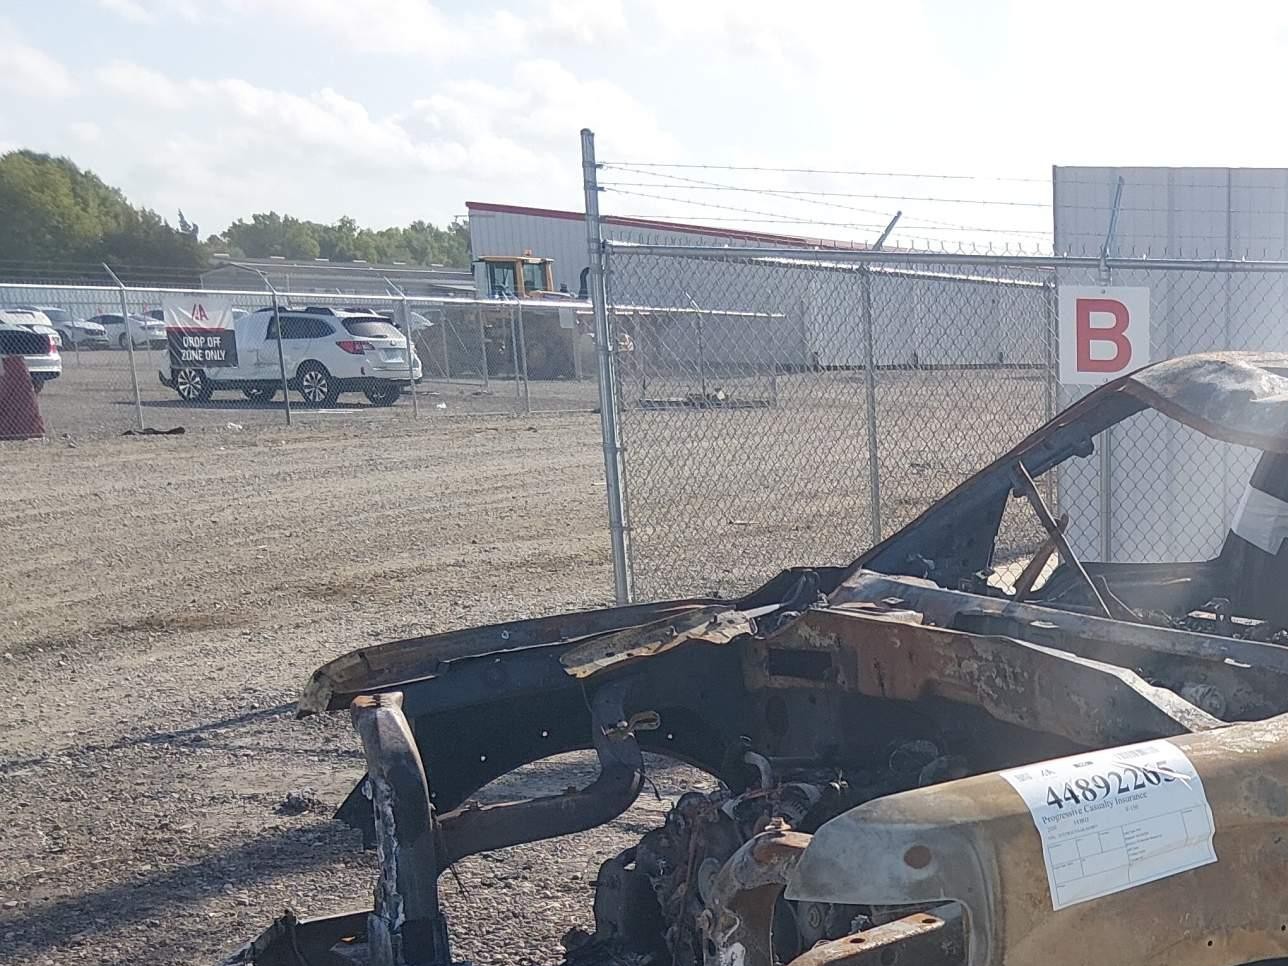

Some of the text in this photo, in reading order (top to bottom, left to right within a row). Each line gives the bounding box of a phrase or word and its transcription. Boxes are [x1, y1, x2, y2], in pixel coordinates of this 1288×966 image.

[182, 337, 221, 348] DROP OFF
[1076, 298, 1132, 373] B
[182, 350, 226, 361] ZONE ONLY
[1046, 761, 1177, 810] 44892265
[1042, 807, 1083, 825] Progressive
[1083, 800, 1114, 814] Casualty
[1114, 791, 1148, 806] Insurance
